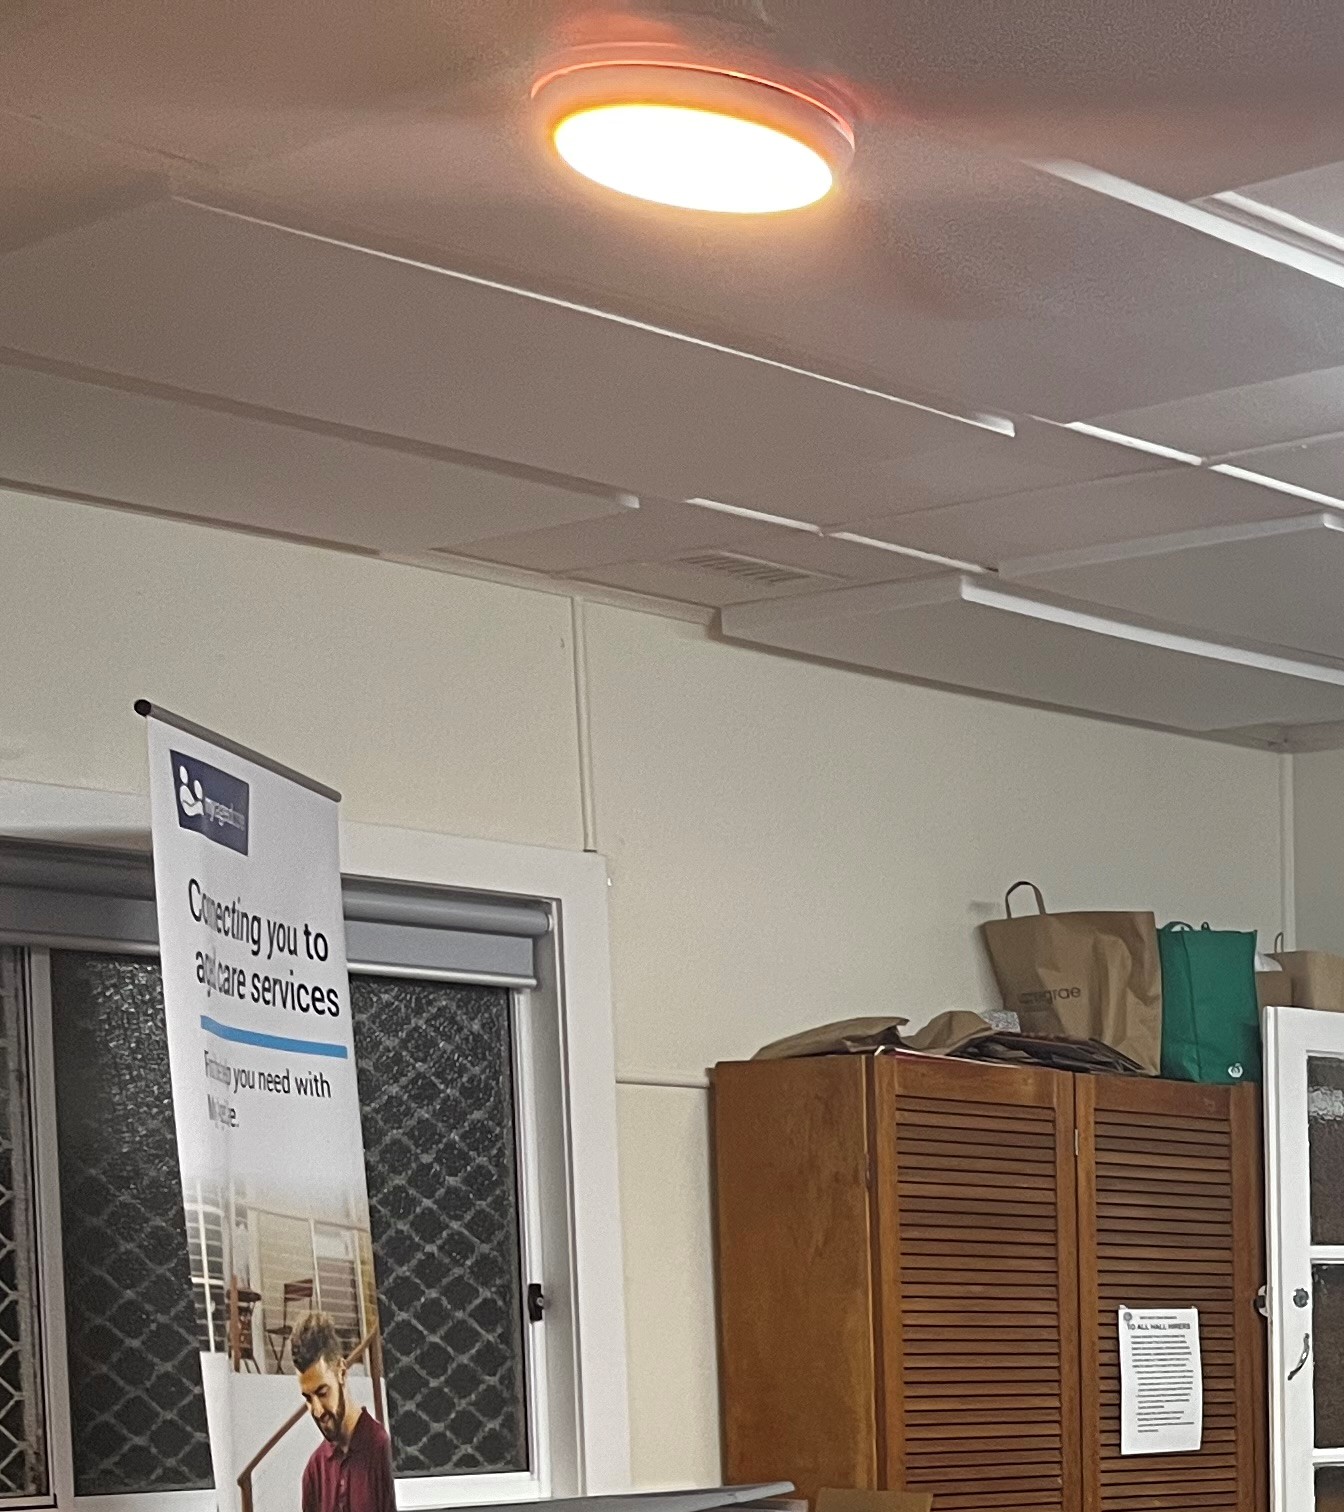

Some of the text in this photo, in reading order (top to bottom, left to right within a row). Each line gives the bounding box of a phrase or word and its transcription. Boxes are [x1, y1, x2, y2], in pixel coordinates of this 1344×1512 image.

[188, 878, 329, 962] Coecting you to
[217, 960, 247, 1000] care
[250, 969, 341, 1018] services
[233, 1066, 256, 1094] you
[258, 1068, 291, 1095] need
[294, 1070, 332, 1099] with
